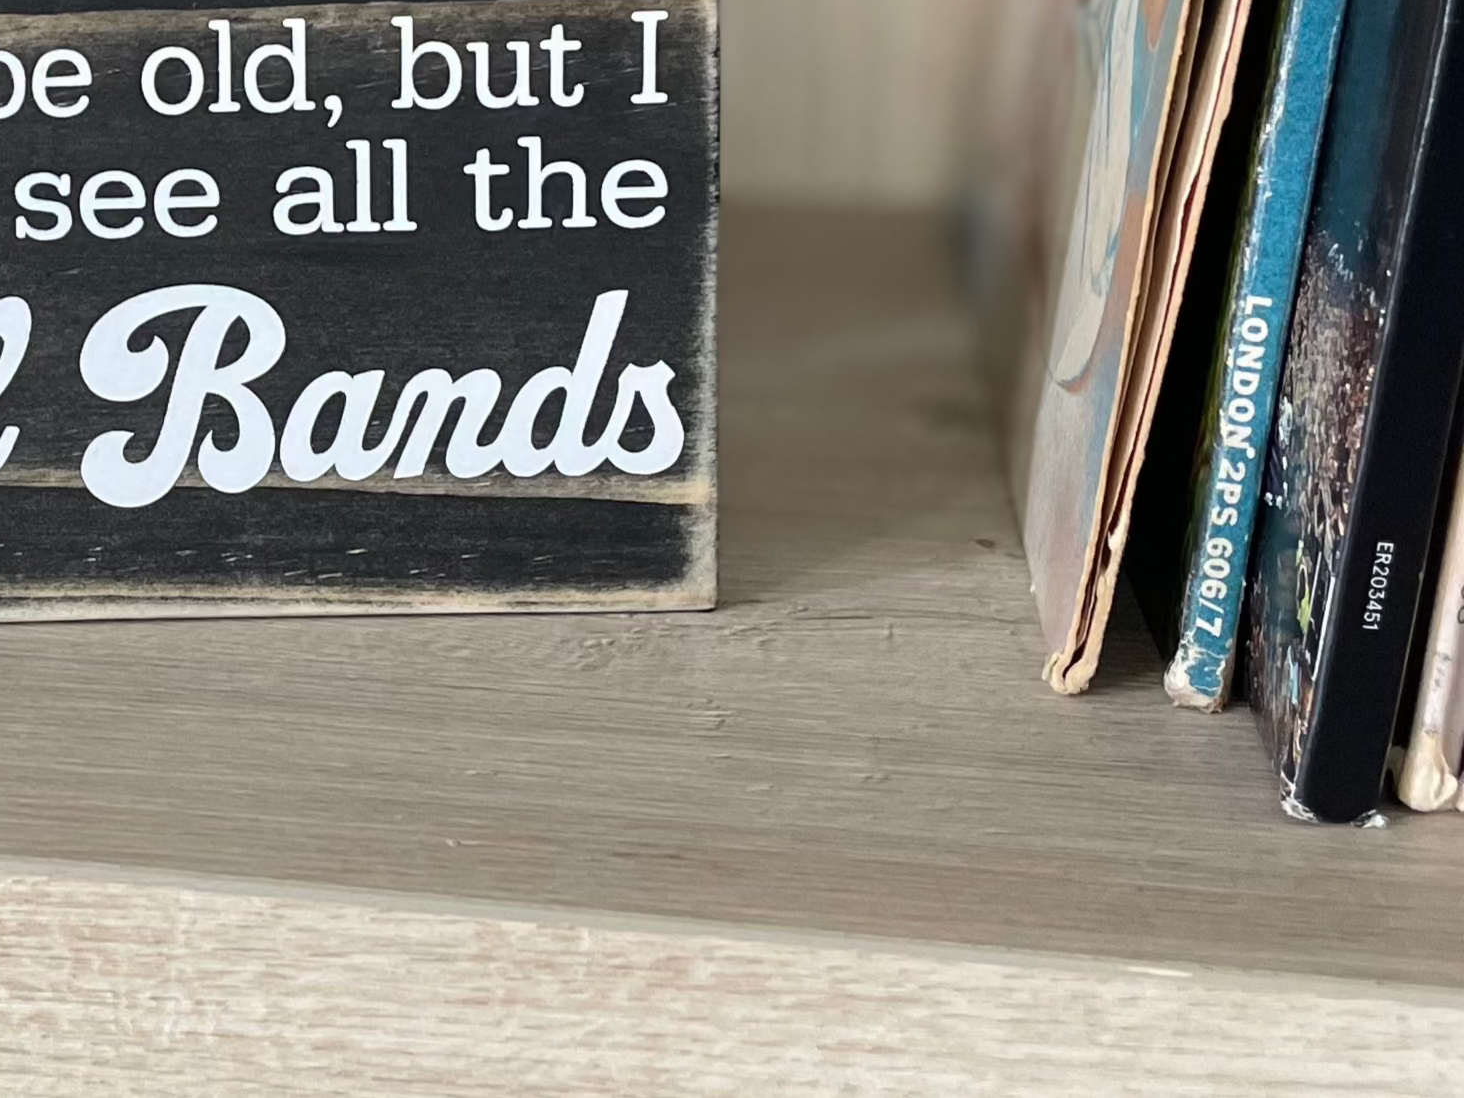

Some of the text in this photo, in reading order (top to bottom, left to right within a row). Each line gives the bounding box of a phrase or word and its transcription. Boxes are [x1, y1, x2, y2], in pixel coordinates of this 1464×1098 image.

[141, 17, 344, 128] old,
[391, 15, 585, 110] but
[630, 10, 669, 105] I
[14, 168, 221, 242] see
[273, 139, 418, 237] all
[463, 136, 669, 232] the
[78, 283, 686, 508] Bands
[1194, 295, 1273, 638] LONDON 2PS 606/7
[1361, 541, 1394, 632] ER203451
